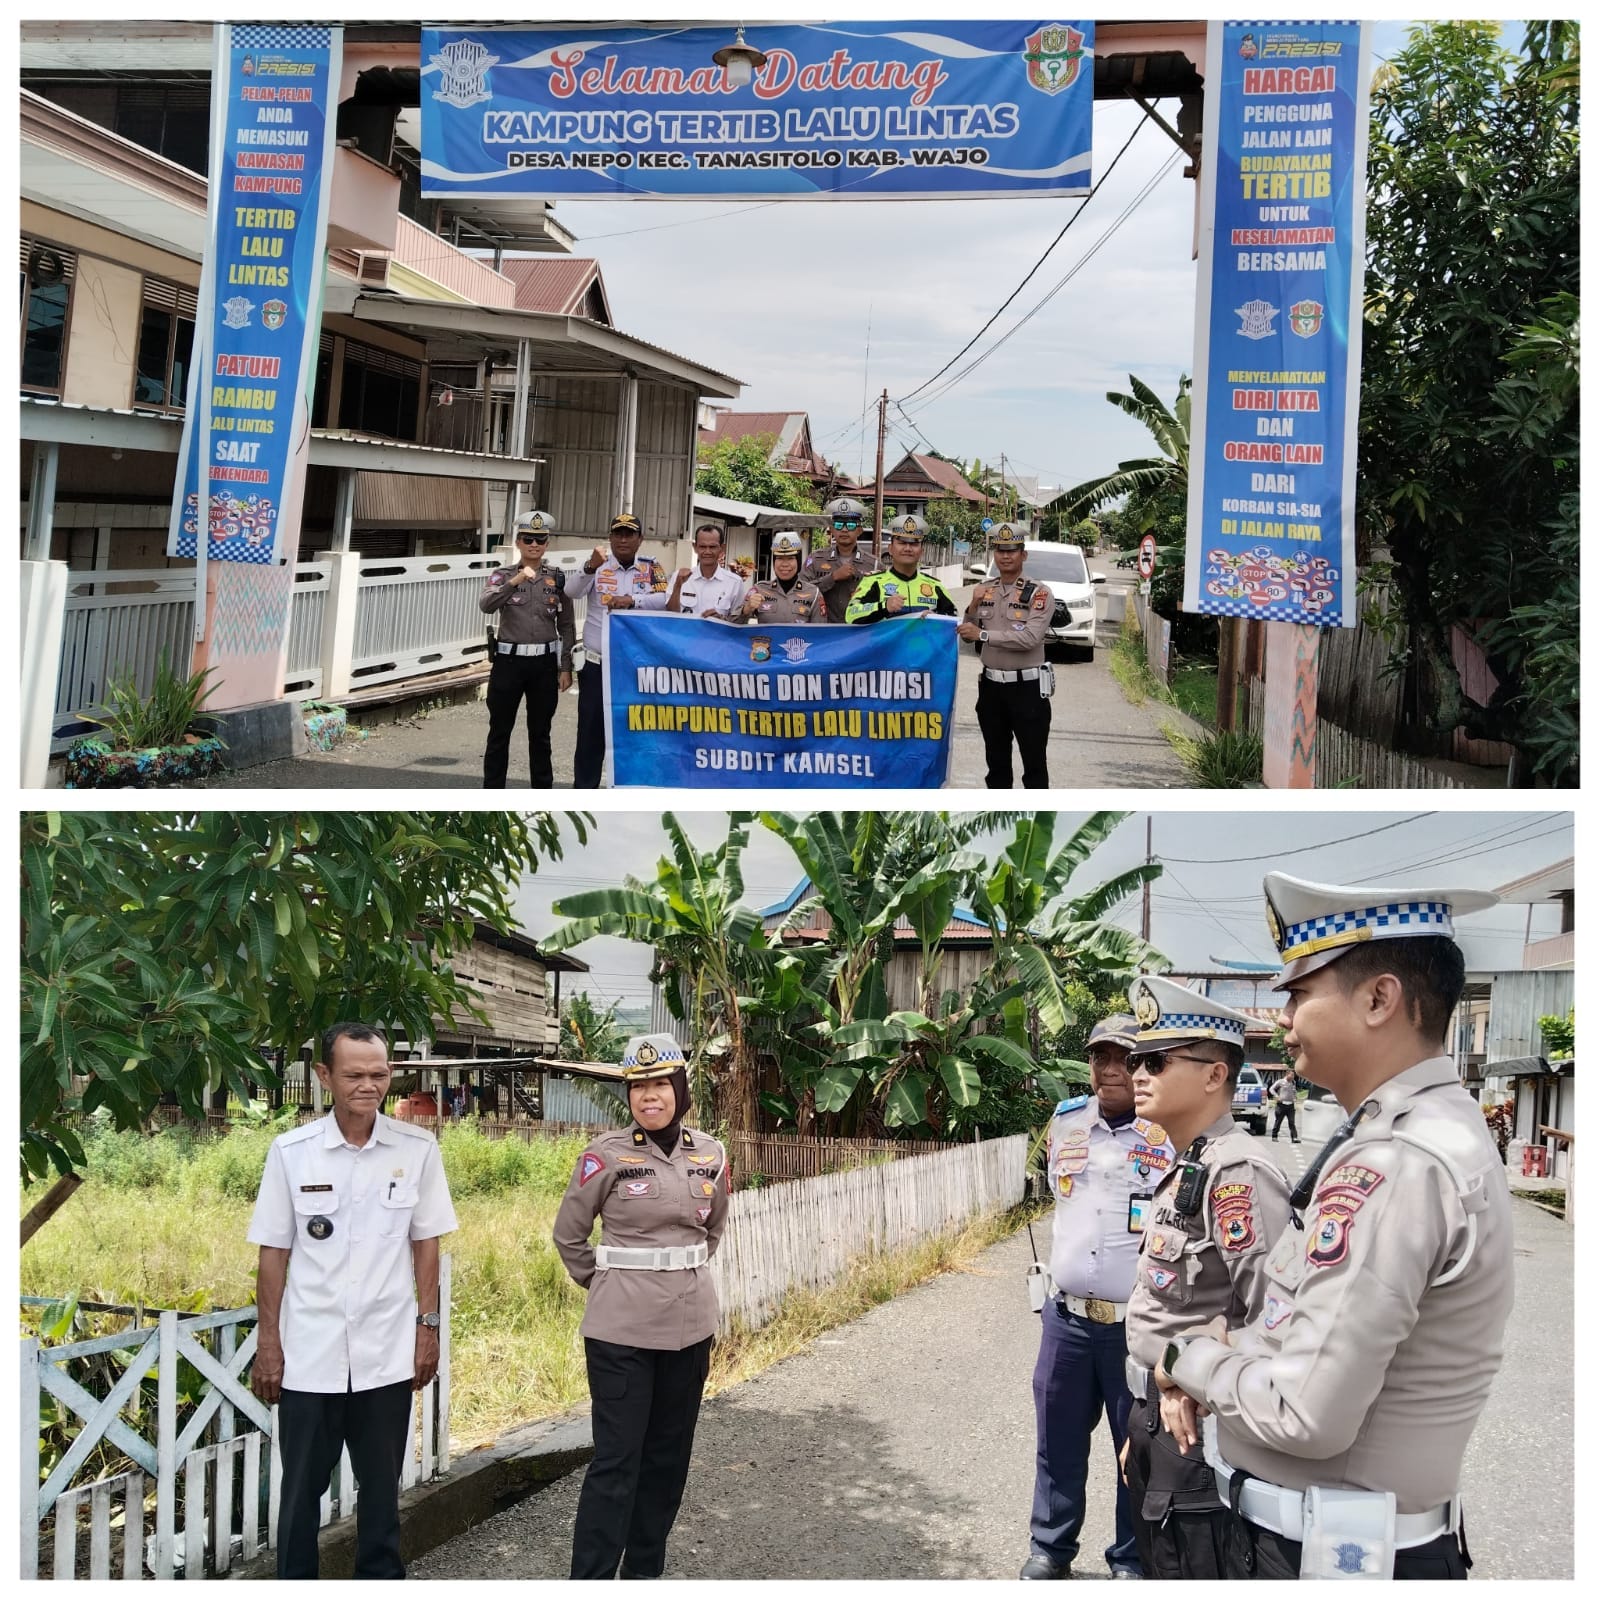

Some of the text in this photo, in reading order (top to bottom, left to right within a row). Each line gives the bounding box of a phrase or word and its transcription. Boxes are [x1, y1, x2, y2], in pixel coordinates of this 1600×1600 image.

[1262, 42, 1342, 57] PRESISI
[257, 63, 317, 75] PRESISI
[752, 48, 949, 105] Datang
[1243, 65, 1336, 95] HARGAI
[241, 87, 313, 102] PELAN-PELAN
[257, 107, 293, 123] ANDA
[1243, 102, 1333, 123] PENGGUNA
[484, 103, 1019, 144] KAMPUNG TERTIB LALU LINTAS
[237, 129, 309, 146] MEMASUKI
[1241, 128, 1332, 149] JALAN LAIN
[236, 153, 304, 170] KAWASAN
[508, 148, 988, 169] DESA NEPO KEC. TANASITOLO KAB. WAJO
[1240, 153, 1332, 172] BUDAYAKAN
[234, 175, 302, 194] KAMPUNG
[1240, 171, 1331, 200] TERTIB
[235, 207, 296, 229] TERTIB
[1259, 205, 1310, 222] UNTUK
[241, 236, 283, 257] LALU
[1231, 227, 1335, 246] KESELAMATAN
[1237, 251, 1326, 272] BERSAMA
[228, 264, 289, 287] LINTAS
[216, 354, 281, 378] PATUHI
[1227, 370, 1326, 384] MENYELAMATKAN
[212, 387, 276, 410] RAMBU
[1232, 389, 1320, 412] DIRI KITA
[237, 418, 274, 434] LINTAS
[1256, 417, 1294, 437] DAN
[216, 440, 260, 462] SAAT
[1223, 441, 1324, 465] ORANG LAIN
[208, 466, 269, 484] ERKENDARA
[1251, 472, 1295, 495] DARI
[209, 510, 226, 518] STOP
[1222, 498, 1322, 518] KORBAN SIA-SIA
[1221, 519, 1322, 541] DI JALAN RAYA
[1242, 569, 1266, 578] STOP
[637, 667, 931, 701] MONITORING DAN EVALUASI
[628, 704, 943, 740] KAMPUNG TERTIB LALU LINTAS
[695, 748, 875, 777] SUBDIT KAMSEL
